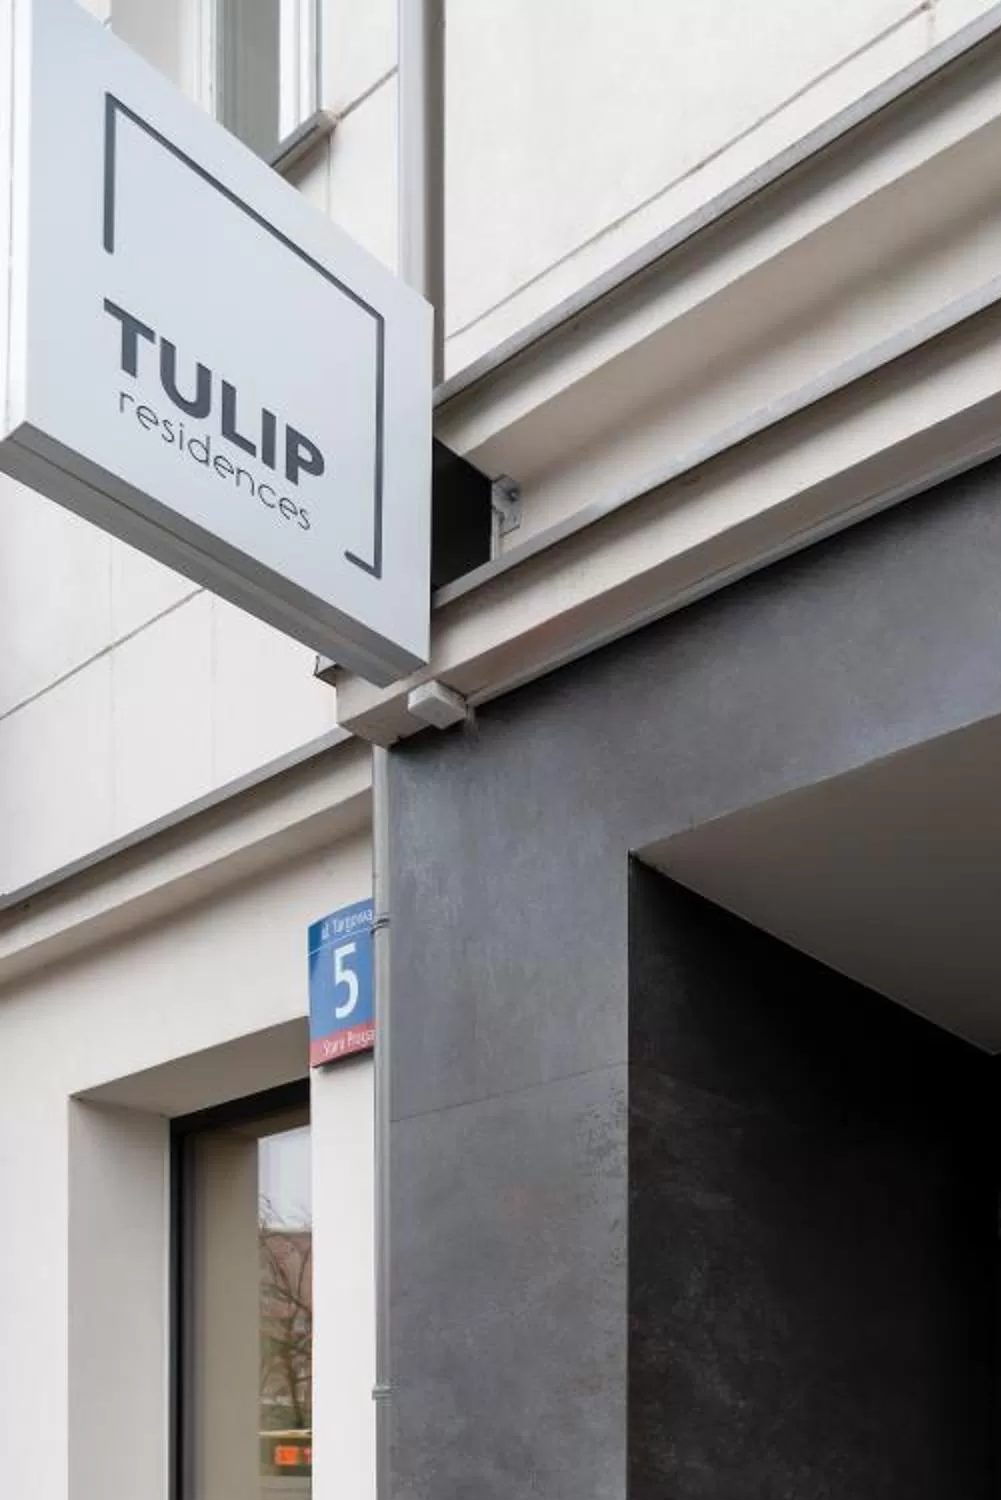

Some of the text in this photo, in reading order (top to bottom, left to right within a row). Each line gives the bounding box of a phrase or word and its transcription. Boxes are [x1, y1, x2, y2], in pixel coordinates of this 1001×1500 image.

[103, 297, 325, 486] TULIP
[118, 391, 311, 531] residences
[333, 942, 359, 1020] 5
